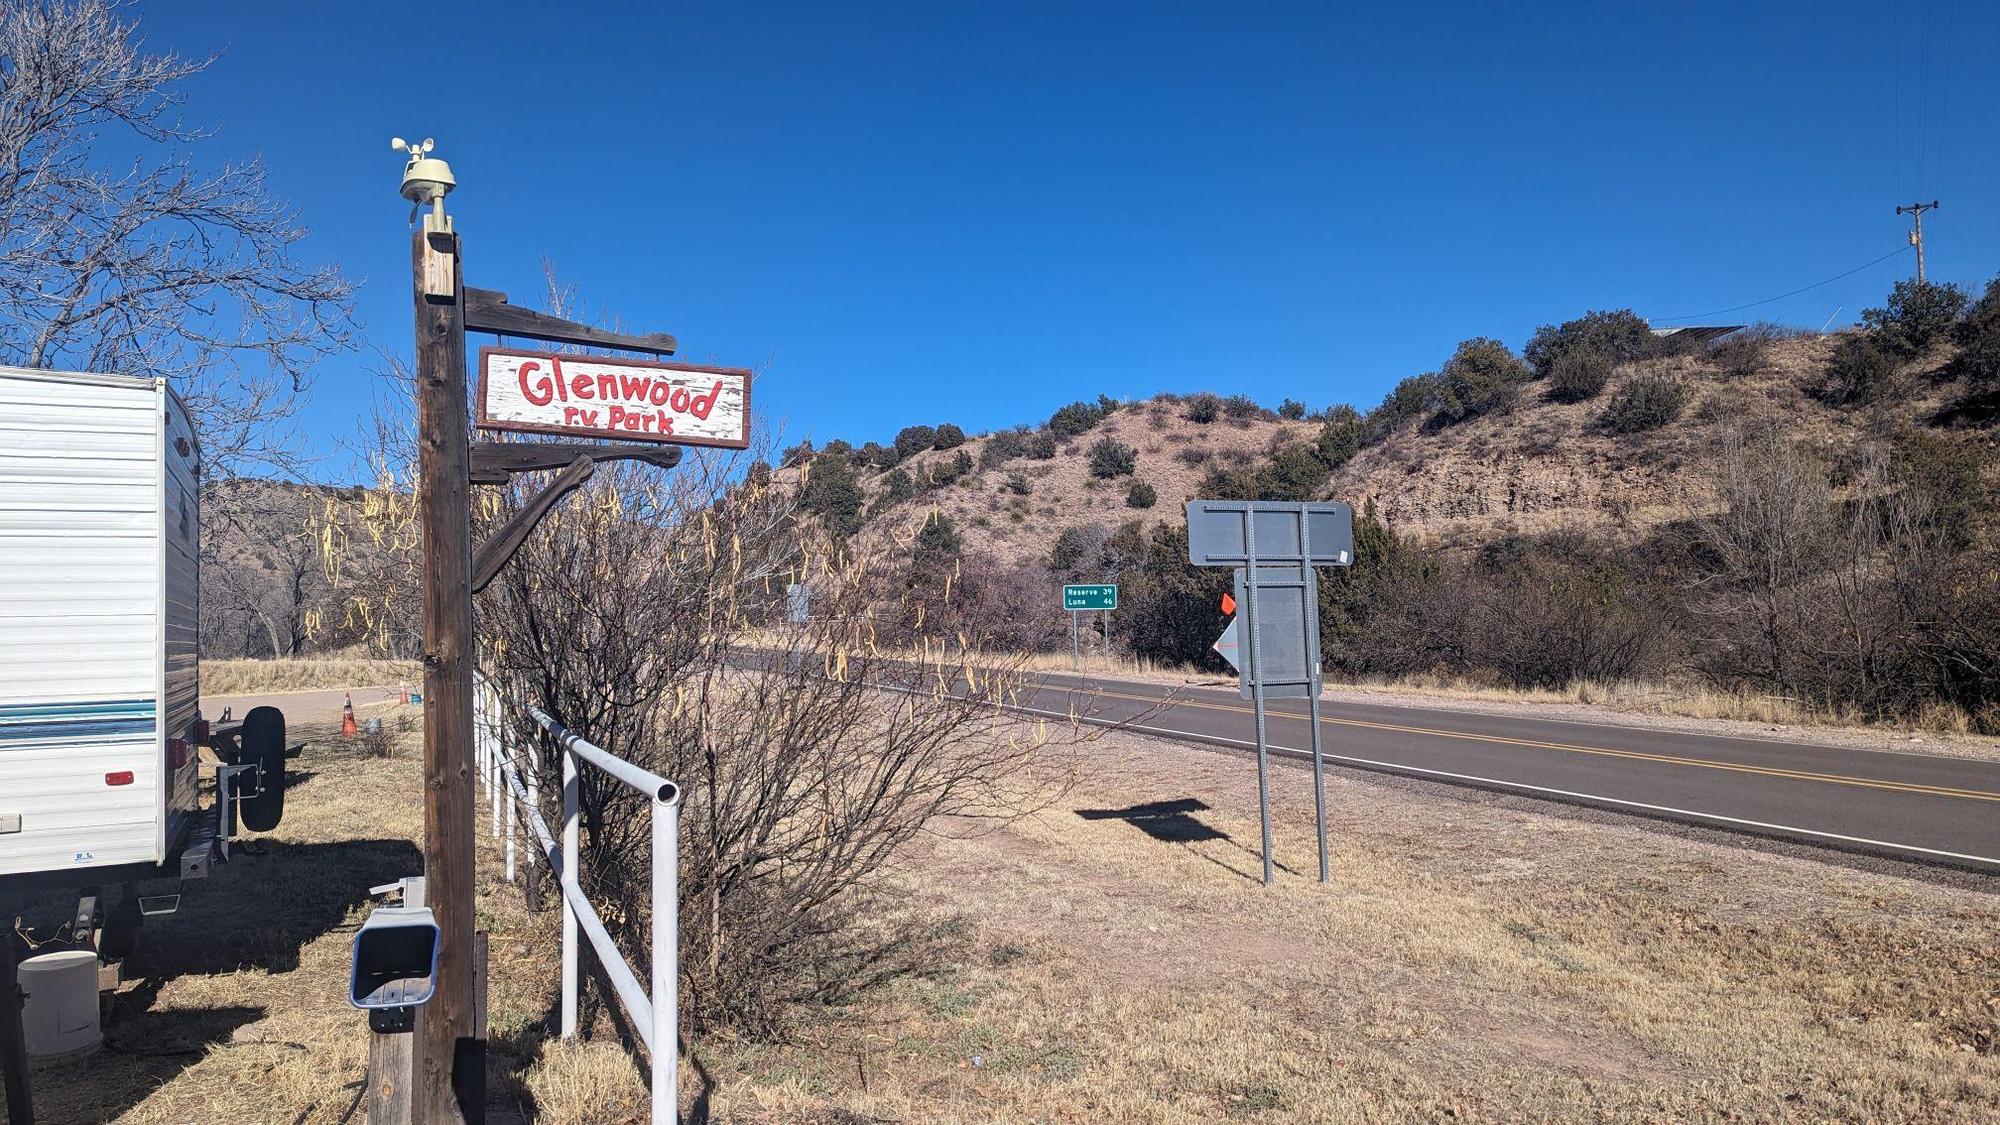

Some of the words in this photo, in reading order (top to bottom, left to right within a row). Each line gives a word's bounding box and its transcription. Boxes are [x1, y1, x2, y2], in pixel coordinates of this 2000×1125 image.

[518, 356, 723, 420] Glenwood
[607, 405, 674, 435] Park
[1067, 588, 1098, 596] Reserve
[1102, 588, 1112, 596] 39
[1068, 598, 1086, 606] Luna
